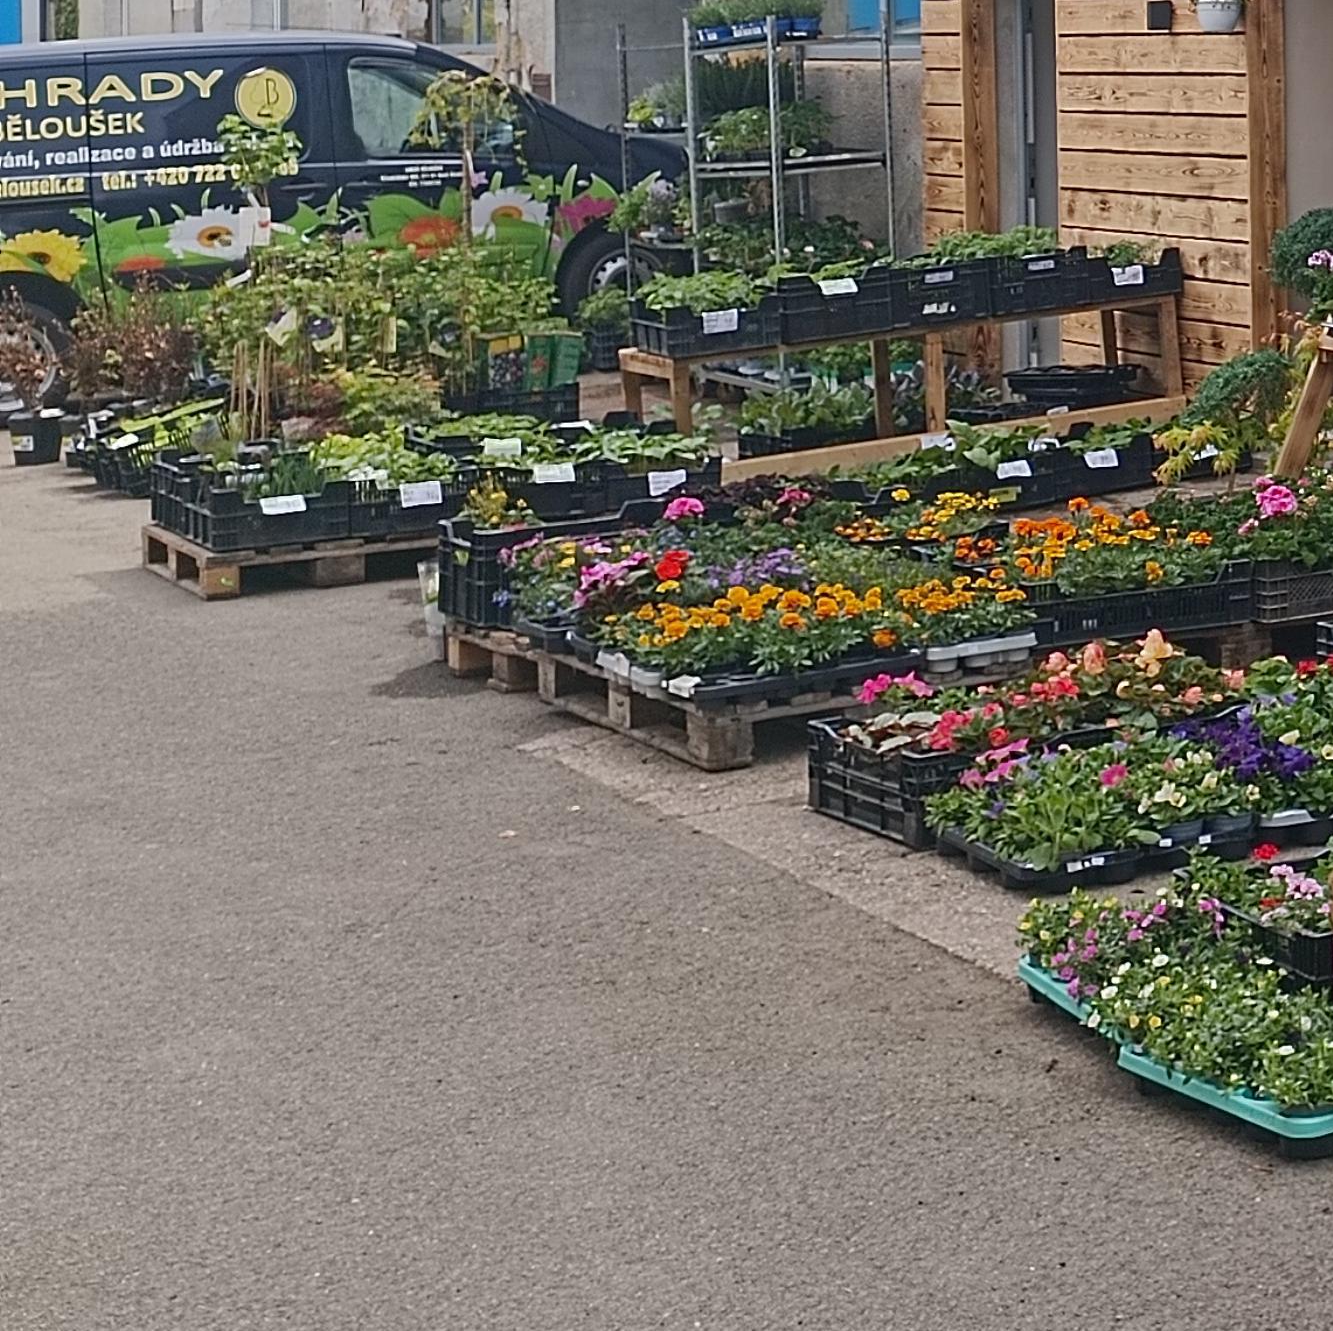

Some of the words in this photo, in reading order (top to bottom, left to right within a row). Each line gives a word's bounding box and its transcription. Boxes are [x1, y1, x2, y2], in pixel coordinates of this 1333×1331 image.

[45, 146, 137, 166] realizace
[142, 145, 155, 159] a
[0, 174, 85, 198] lousek.cz
